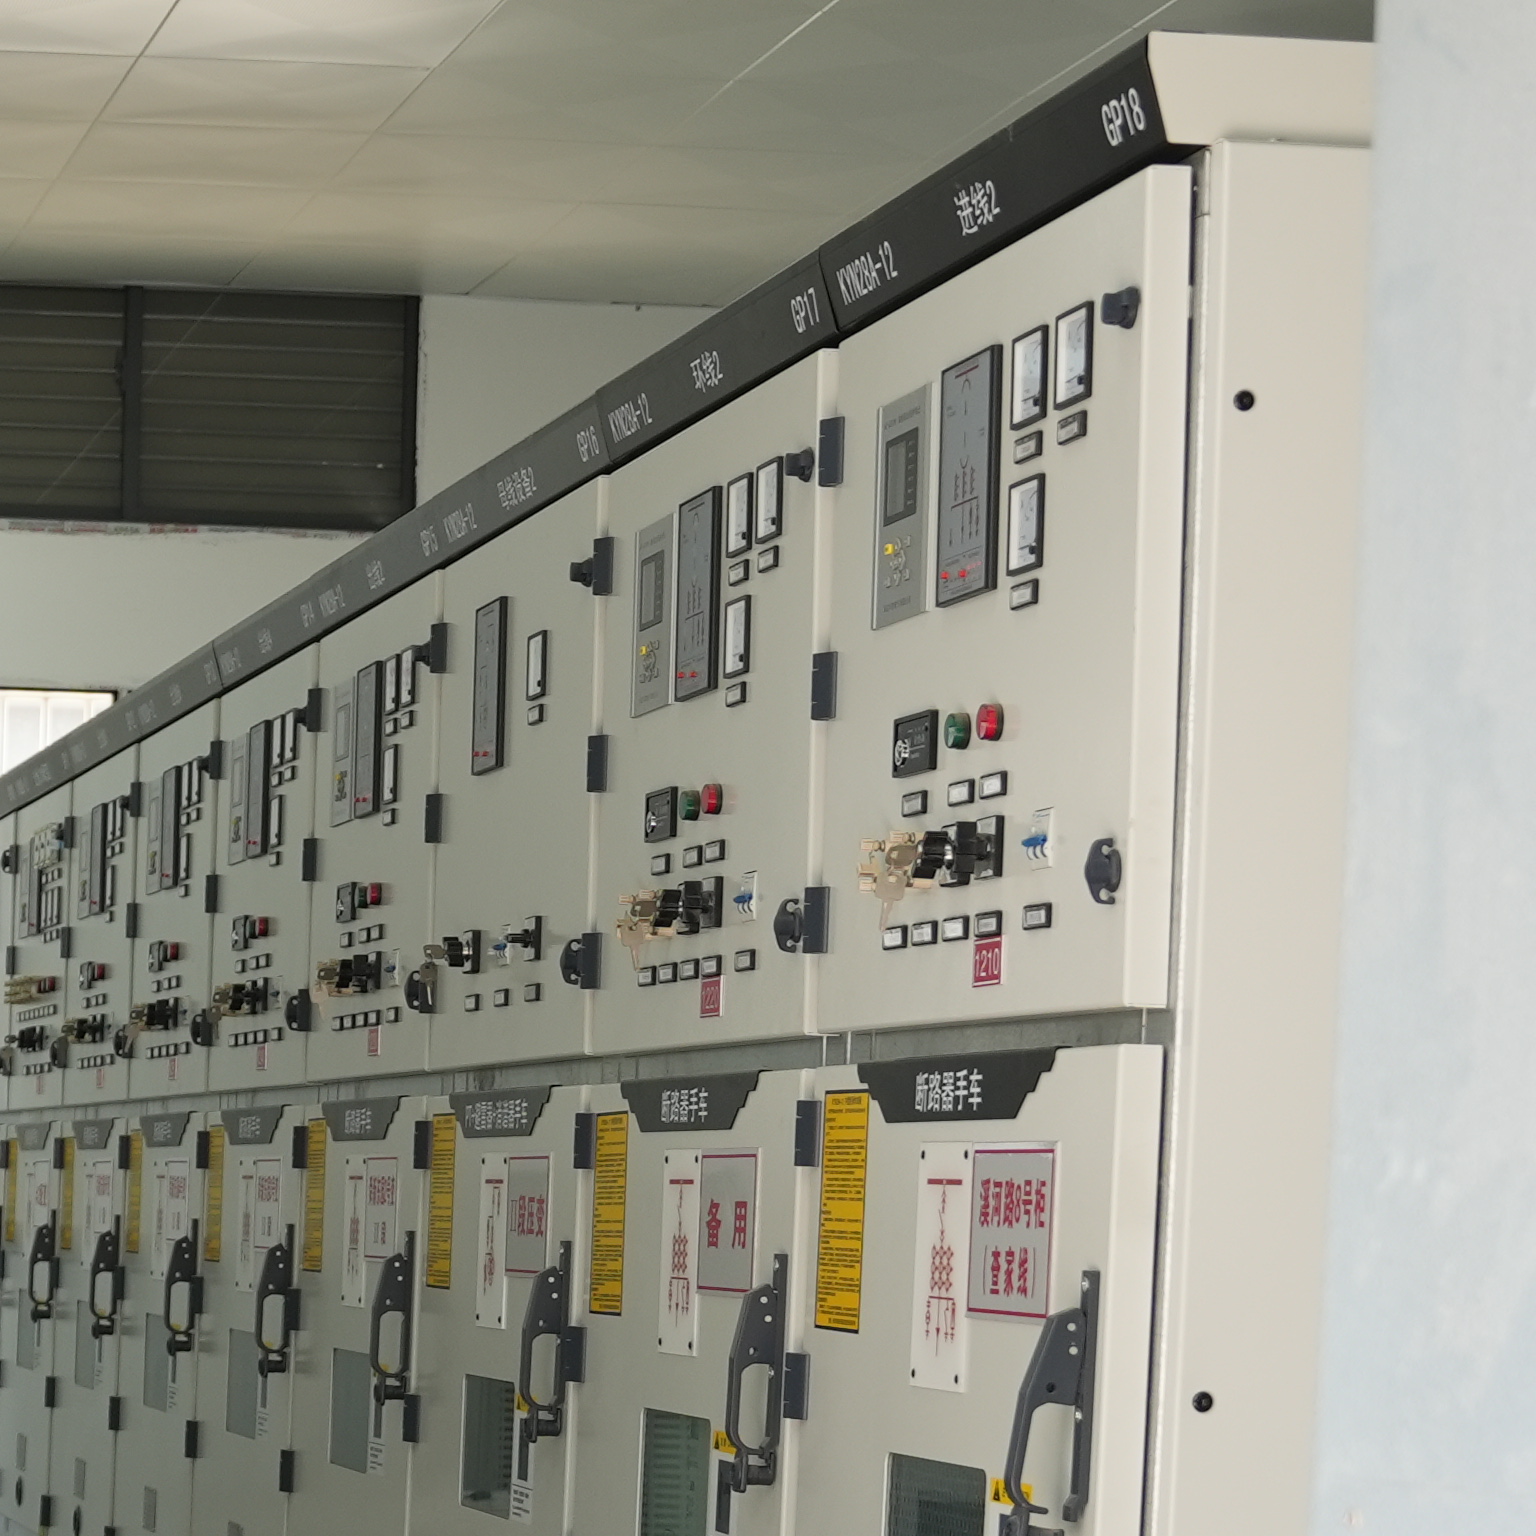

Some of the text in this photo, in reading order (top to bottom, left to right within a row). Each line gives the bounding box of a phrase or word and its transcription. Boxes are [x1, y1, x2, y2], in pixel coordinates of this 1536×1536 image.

[1101, 87, 1148, 148] GP18
[953, 178, 1001, 237] 进线2
[835, 241, 899, 307] KYN28A-12
[790, 286, 821, 335] GP17
[690, 350, 724, 395] 环线2
[608, 392, 653, 444] KYN28A-12
[576, 425, 600, 463] GP16
[975, 947, 1000, 978] 1210
[702, 986, 720, 1011] 1220
[660, 1086, 709, 1124] 断路器手车
[914, 1067, 984, 1114] 断路器手车
[705, 1196, 749, 1251] 备用
[978, 1176, 1047, 1230] 溪河路8号柜
